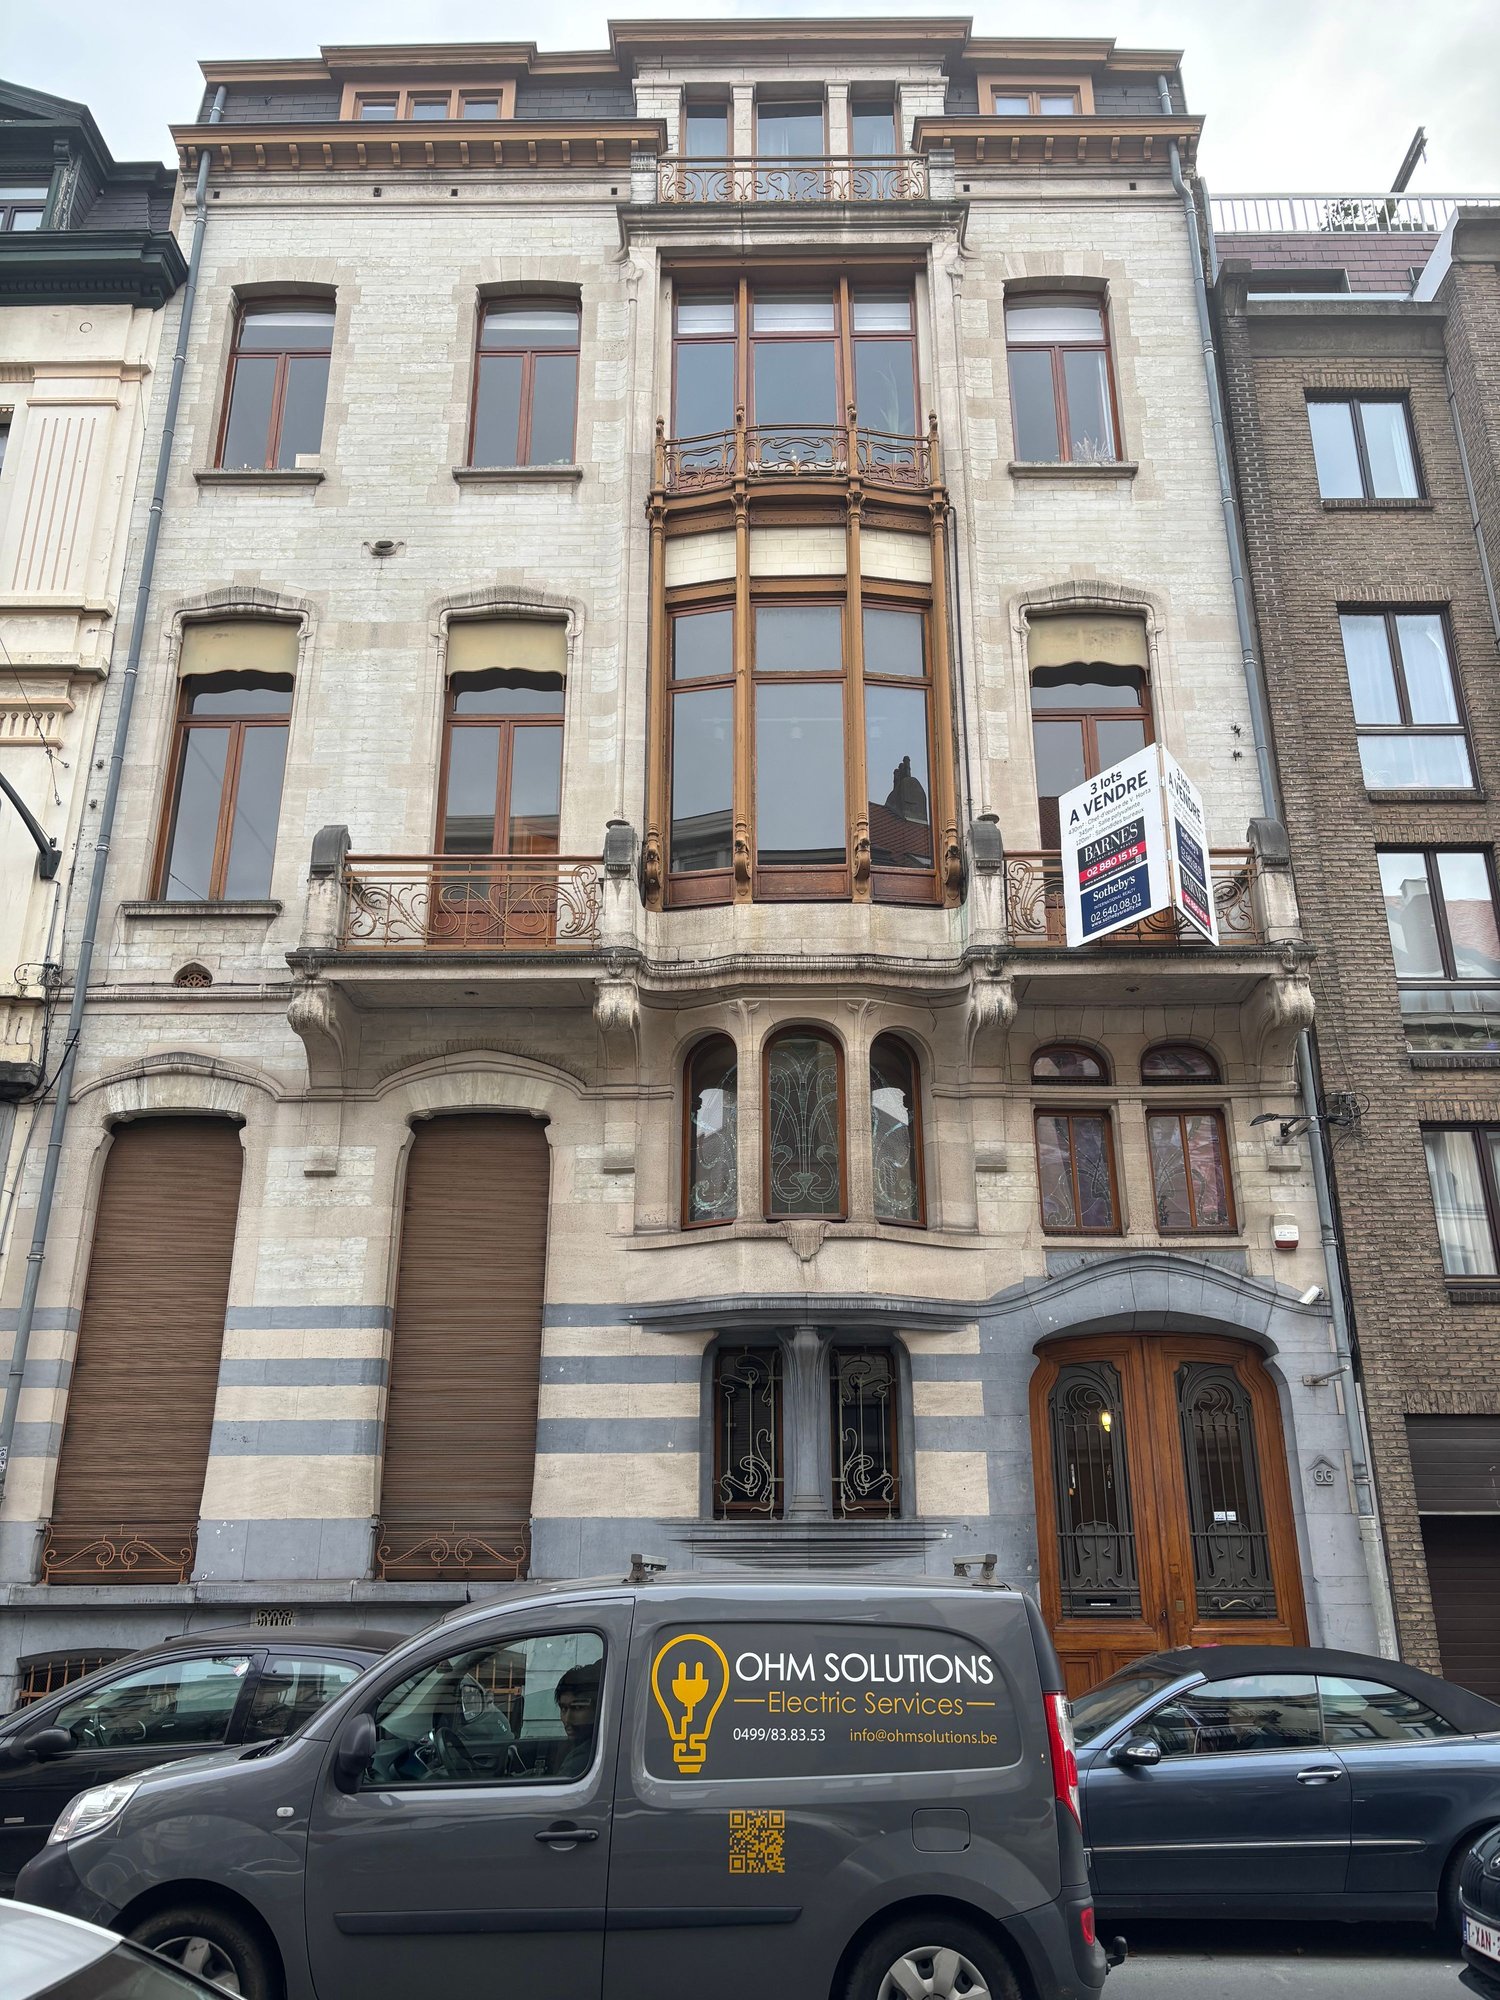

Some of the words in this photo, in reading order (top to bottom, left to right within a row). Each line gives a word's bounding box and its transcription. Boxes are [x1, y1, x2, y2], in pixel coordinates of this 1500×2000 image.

[1090, 782, 1098, 795] 3
[1100, 771, 1122, 789] lots
[1176, 768, 1181, 781] 3
[1070, 809, 1080, 826] A
[1083, 770, 1148, 816] VENDRE
[1168, 772, 1174, 789] A
[1174, 778, 1202, 825] VENDRE
[1084, 822, 1138, 862] BARNES
[1086, 866, 1098, 877] 02
[1099, 859, 1117, 872] 880
[1118, 853, 1127, 862] 15
[1128, 847, 1138, 857] 15
[1093, 875, 1136, 902] Sotheby's
[1090, 892, 1141, 922] 02.640.08.01
[736, 1652, 816, 1682] OHM
[824, 1652, 994, 1685] SOLUTIONS
[768, 1690, 857, 1714] Electric
[864, 1692, 964, 1716] Services
[733, 1727, 826, 1742] 0499/83.83.53
[849, 1727, 998, 1744] info@ohmsolutions.be
